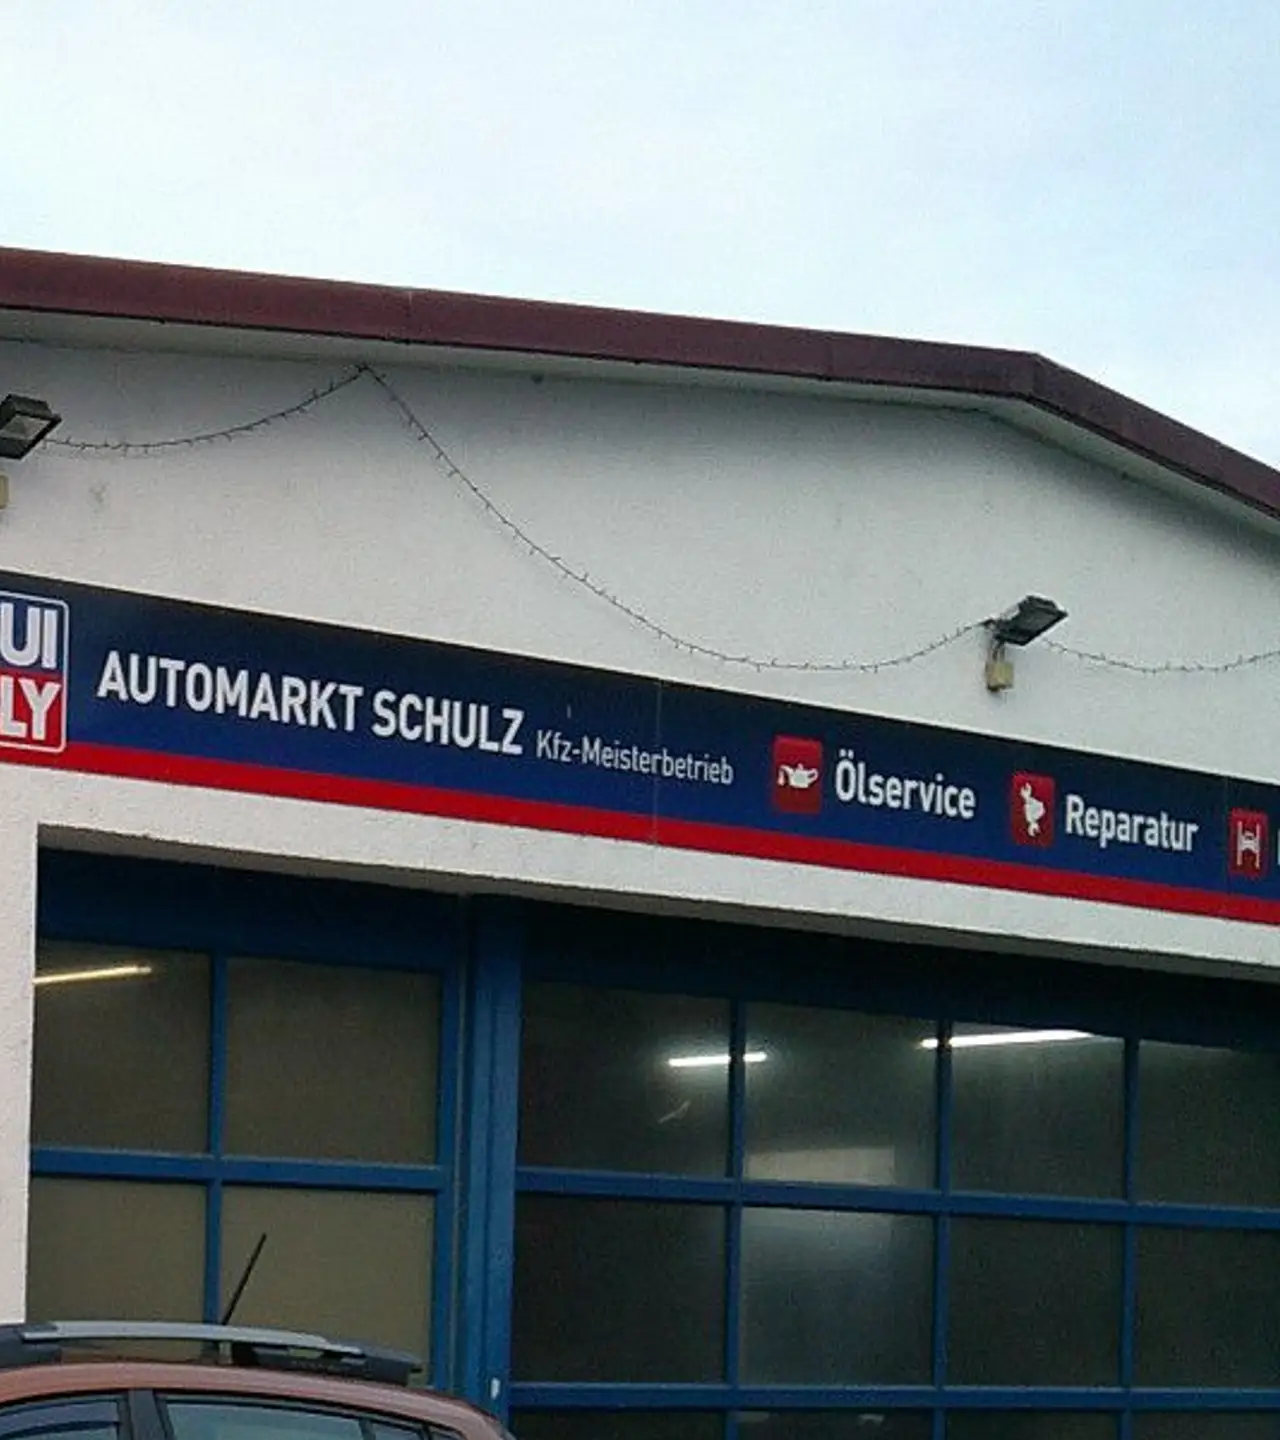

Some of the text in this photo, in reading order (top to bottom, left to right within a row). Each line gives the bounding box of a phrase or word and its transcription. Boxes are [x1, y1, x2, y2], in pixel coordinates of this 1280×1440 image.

[96, 650, 734, 786] AUTOMARKT SCHULZ Kfz-Meisterbetrieb
[835, 749, 976, 820] Ölservice
[1064, 794, 1200, 852] Reparatur
